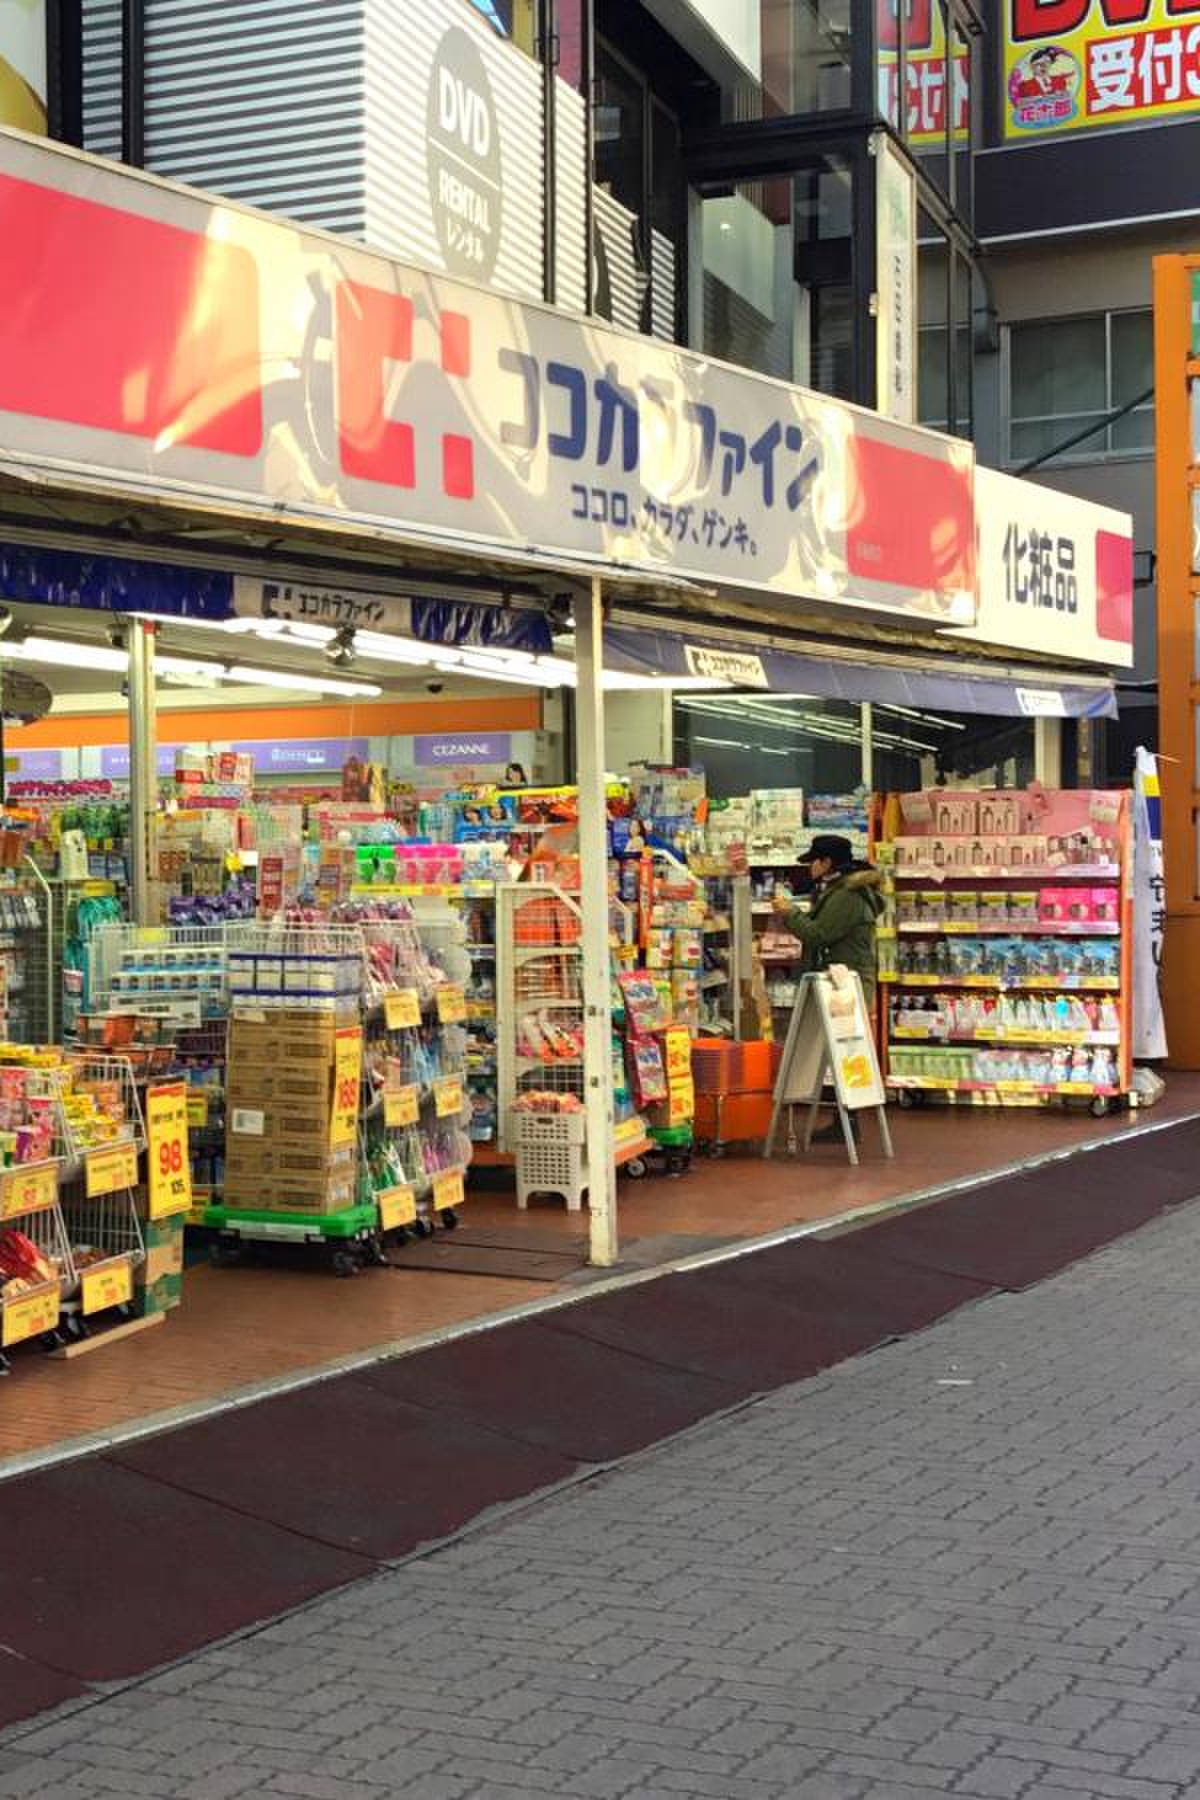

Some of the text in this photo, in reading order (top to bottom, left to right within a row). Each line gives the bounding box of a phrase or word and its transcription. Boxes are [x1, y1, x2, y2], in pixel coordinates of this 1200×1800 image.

[439, 64, 490, 157] DVD
[438, 167, 491, 236] RENTAL
[446, 215, 484, 264] レンタル
[1002, 521, 1078, 614] 化粧品
[159, 1138, 183, 1176] 98
